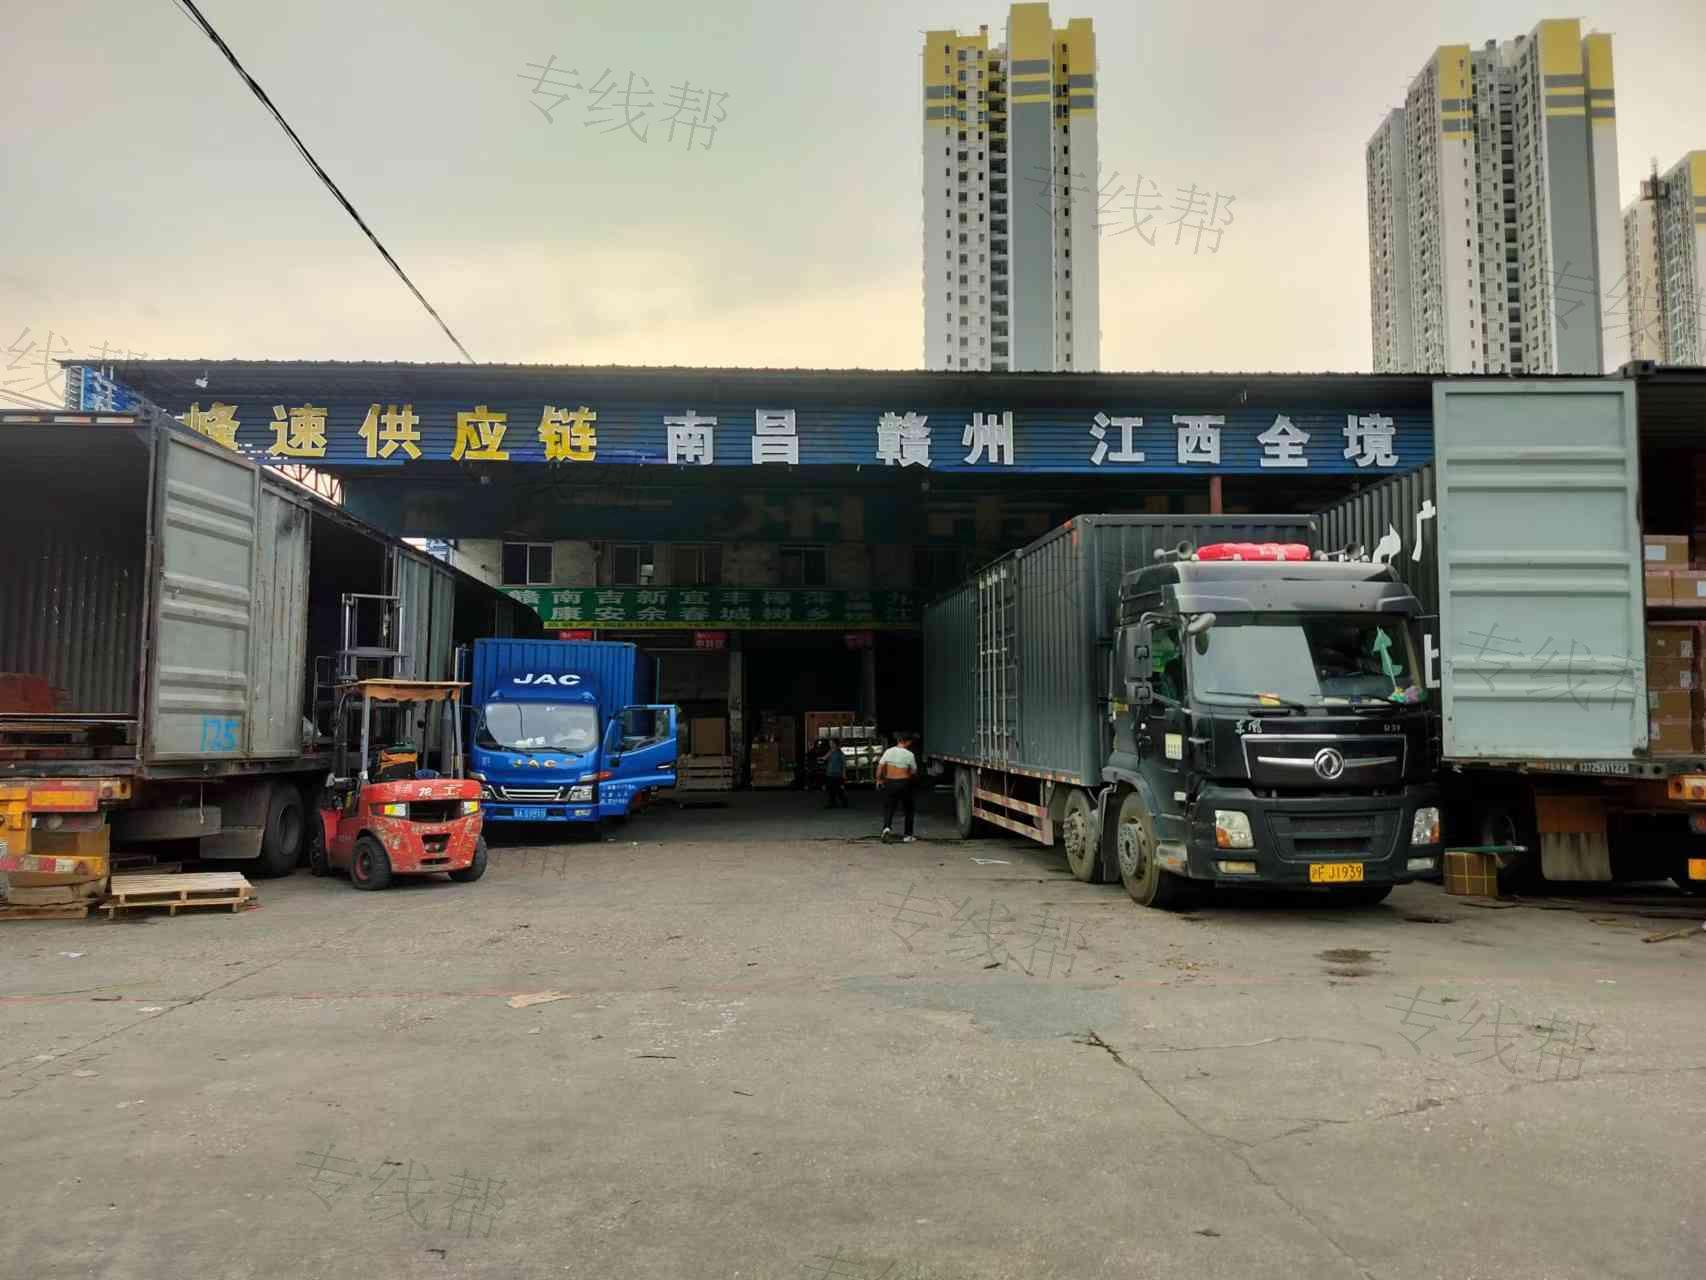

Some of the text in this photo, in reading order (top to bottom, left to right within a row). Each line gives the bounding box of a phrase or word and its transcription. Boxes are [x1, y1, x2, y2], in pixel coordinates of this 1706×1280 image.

[663, 409, 799, 465] 南昌
[1090, 411, 1399, 467] 江西全境
[513, 673, 581, 685] JAC
